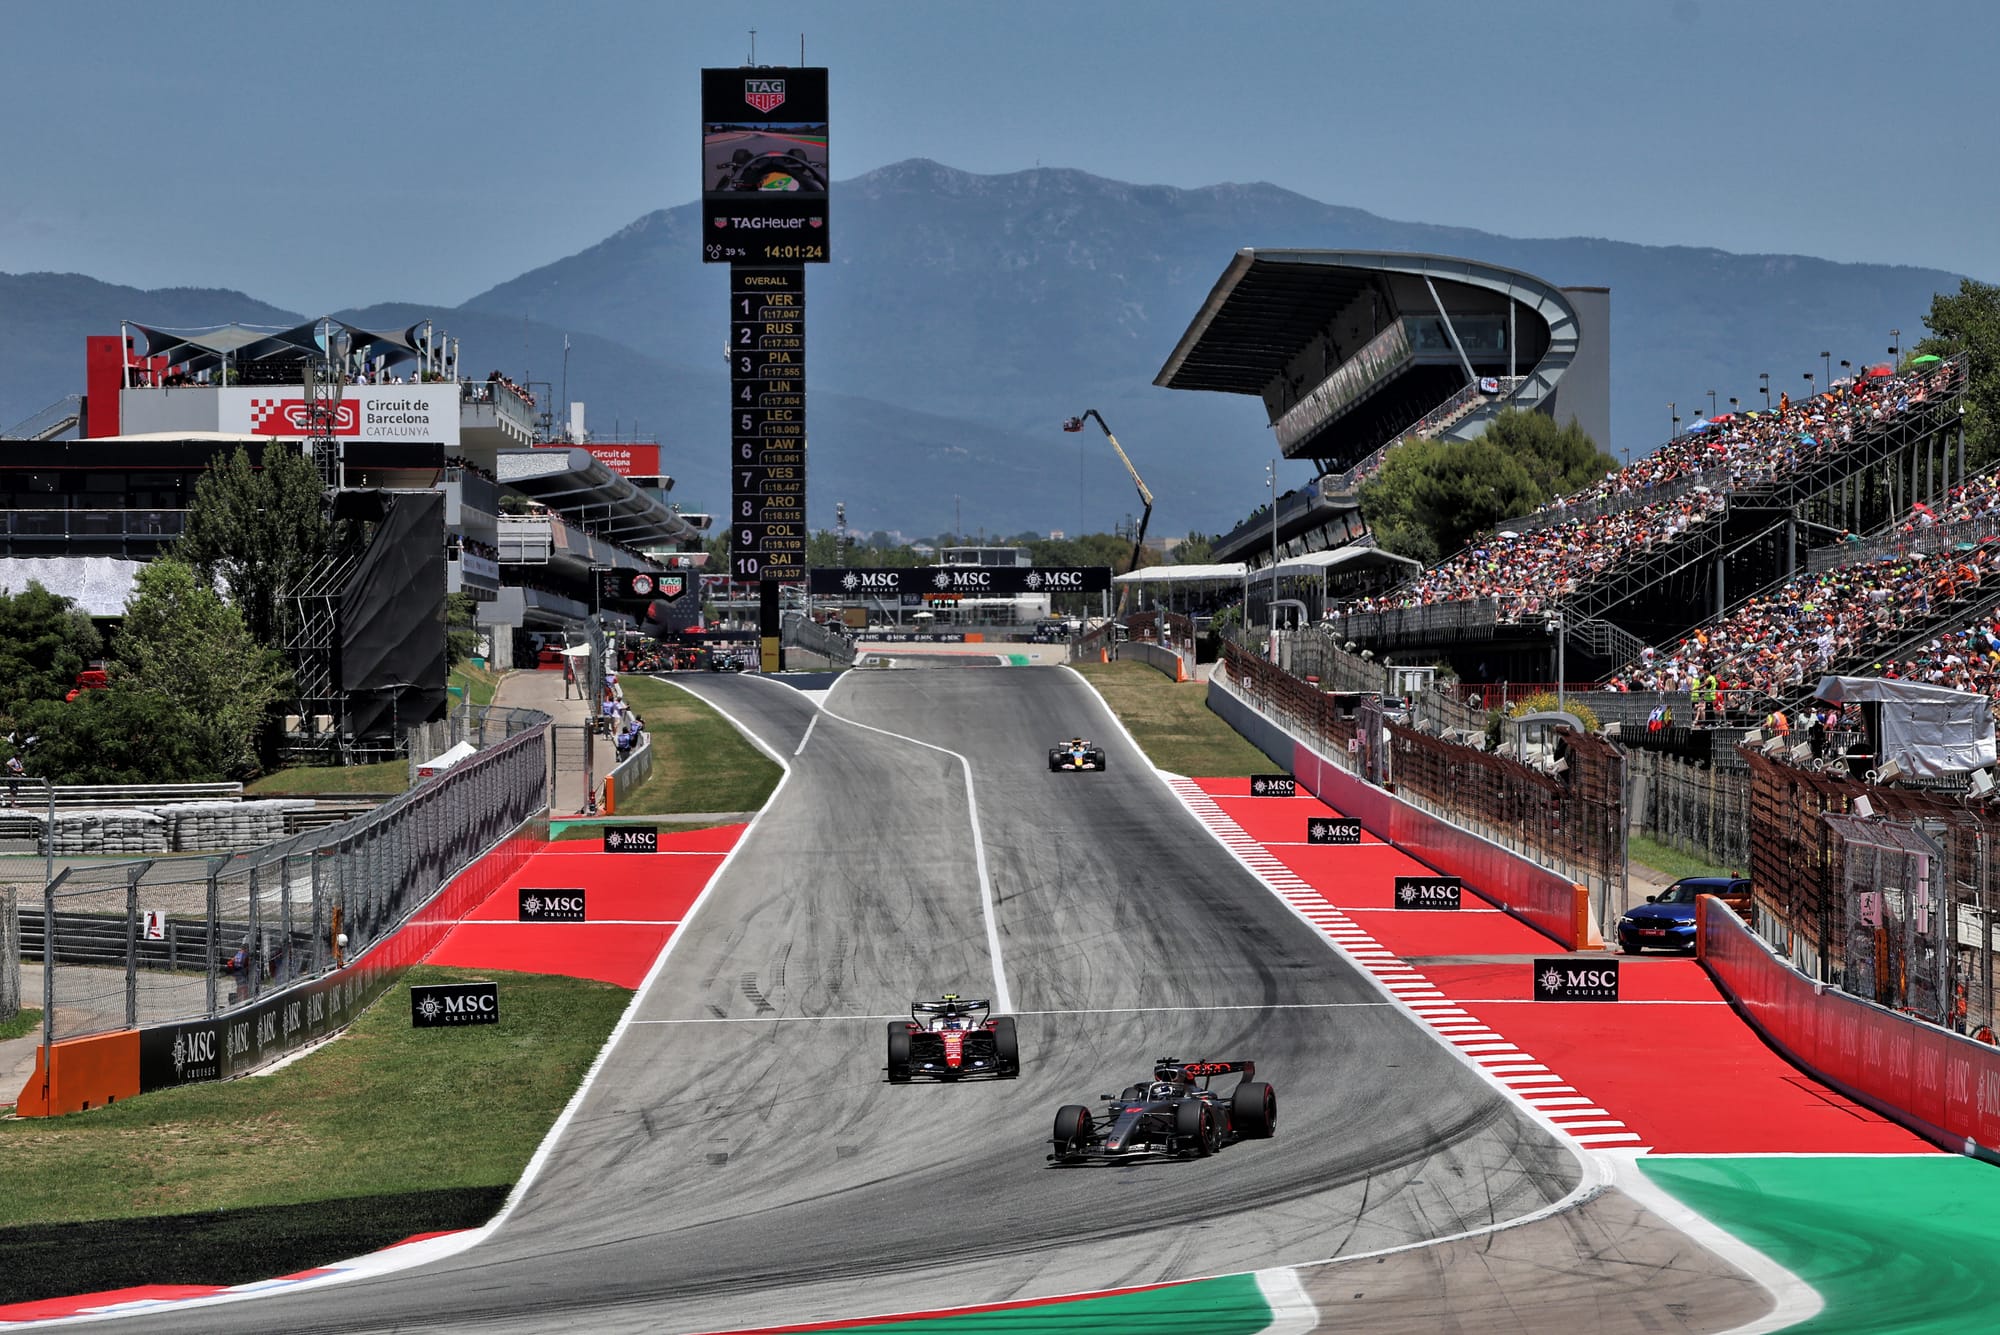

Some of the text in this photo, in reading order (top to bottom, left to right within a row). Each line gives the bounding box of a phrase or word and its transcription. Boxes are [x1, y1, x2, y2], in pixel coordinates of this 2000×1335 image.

[748, 82, 782, 92] TAG
[748, 94, 782, 110] HEUER
[725, 248, 736, 256] 39
[764, 245, 822, 258] 14:01:24
[744, 276, 788, 286] OVERALL
[741, 294, 794, 315] 1 VER
[764, 310, 800, 319] 1:17.047
[740, 324, 794, 344] 2 RUS
[741, 352, 791, 372] 3 PIA
[741, 381, 790, 401] 4 LIN
[367, 400, 429, 410] Circuit de
[367, 413, 429, 424] Barcelona
[742, 410, 792, 430] 5 LEC
[366, 427, 429, 436] CATALUNYA
[592, 450, 631, 458] Circuit de
[742, 439, 795, 459] 6 LAW
[742, 468, 794, 488] 7 VES
[742, 496, 795, 516] 8 ARO
[764, 512, 800, 520] 1:18.515
[742, 525, 794, 545] 9 COL
[765, 540, 800, 549] 1:19.169
[737, 554, 791, 574] 10 SAI
[861, 573, 899, 586] MSC
[953, 572, 990, 585] MSC
[1044, 572, 1082, 585] MSC
[1268, 780, 1294, 790] MSC
[1328, 825, 1359, 836] MSC
[624, 833, 655, 844] MSC
[1420, 886, 1458, 899] MSC
[544, 897, 583, 911] MSC
[1567, 970, 1616, 988] MSC
[444, 994, 494, 1013] MSC
[445, 1014, 496, 1022] CRUISES
[234, 1022, 249, 1054] MSC
[187, 1030, 216, 1063] MSC
[187, 1066, 216, 1078] CRUISES
[1953, 1058, 1969, 1104] MSC
